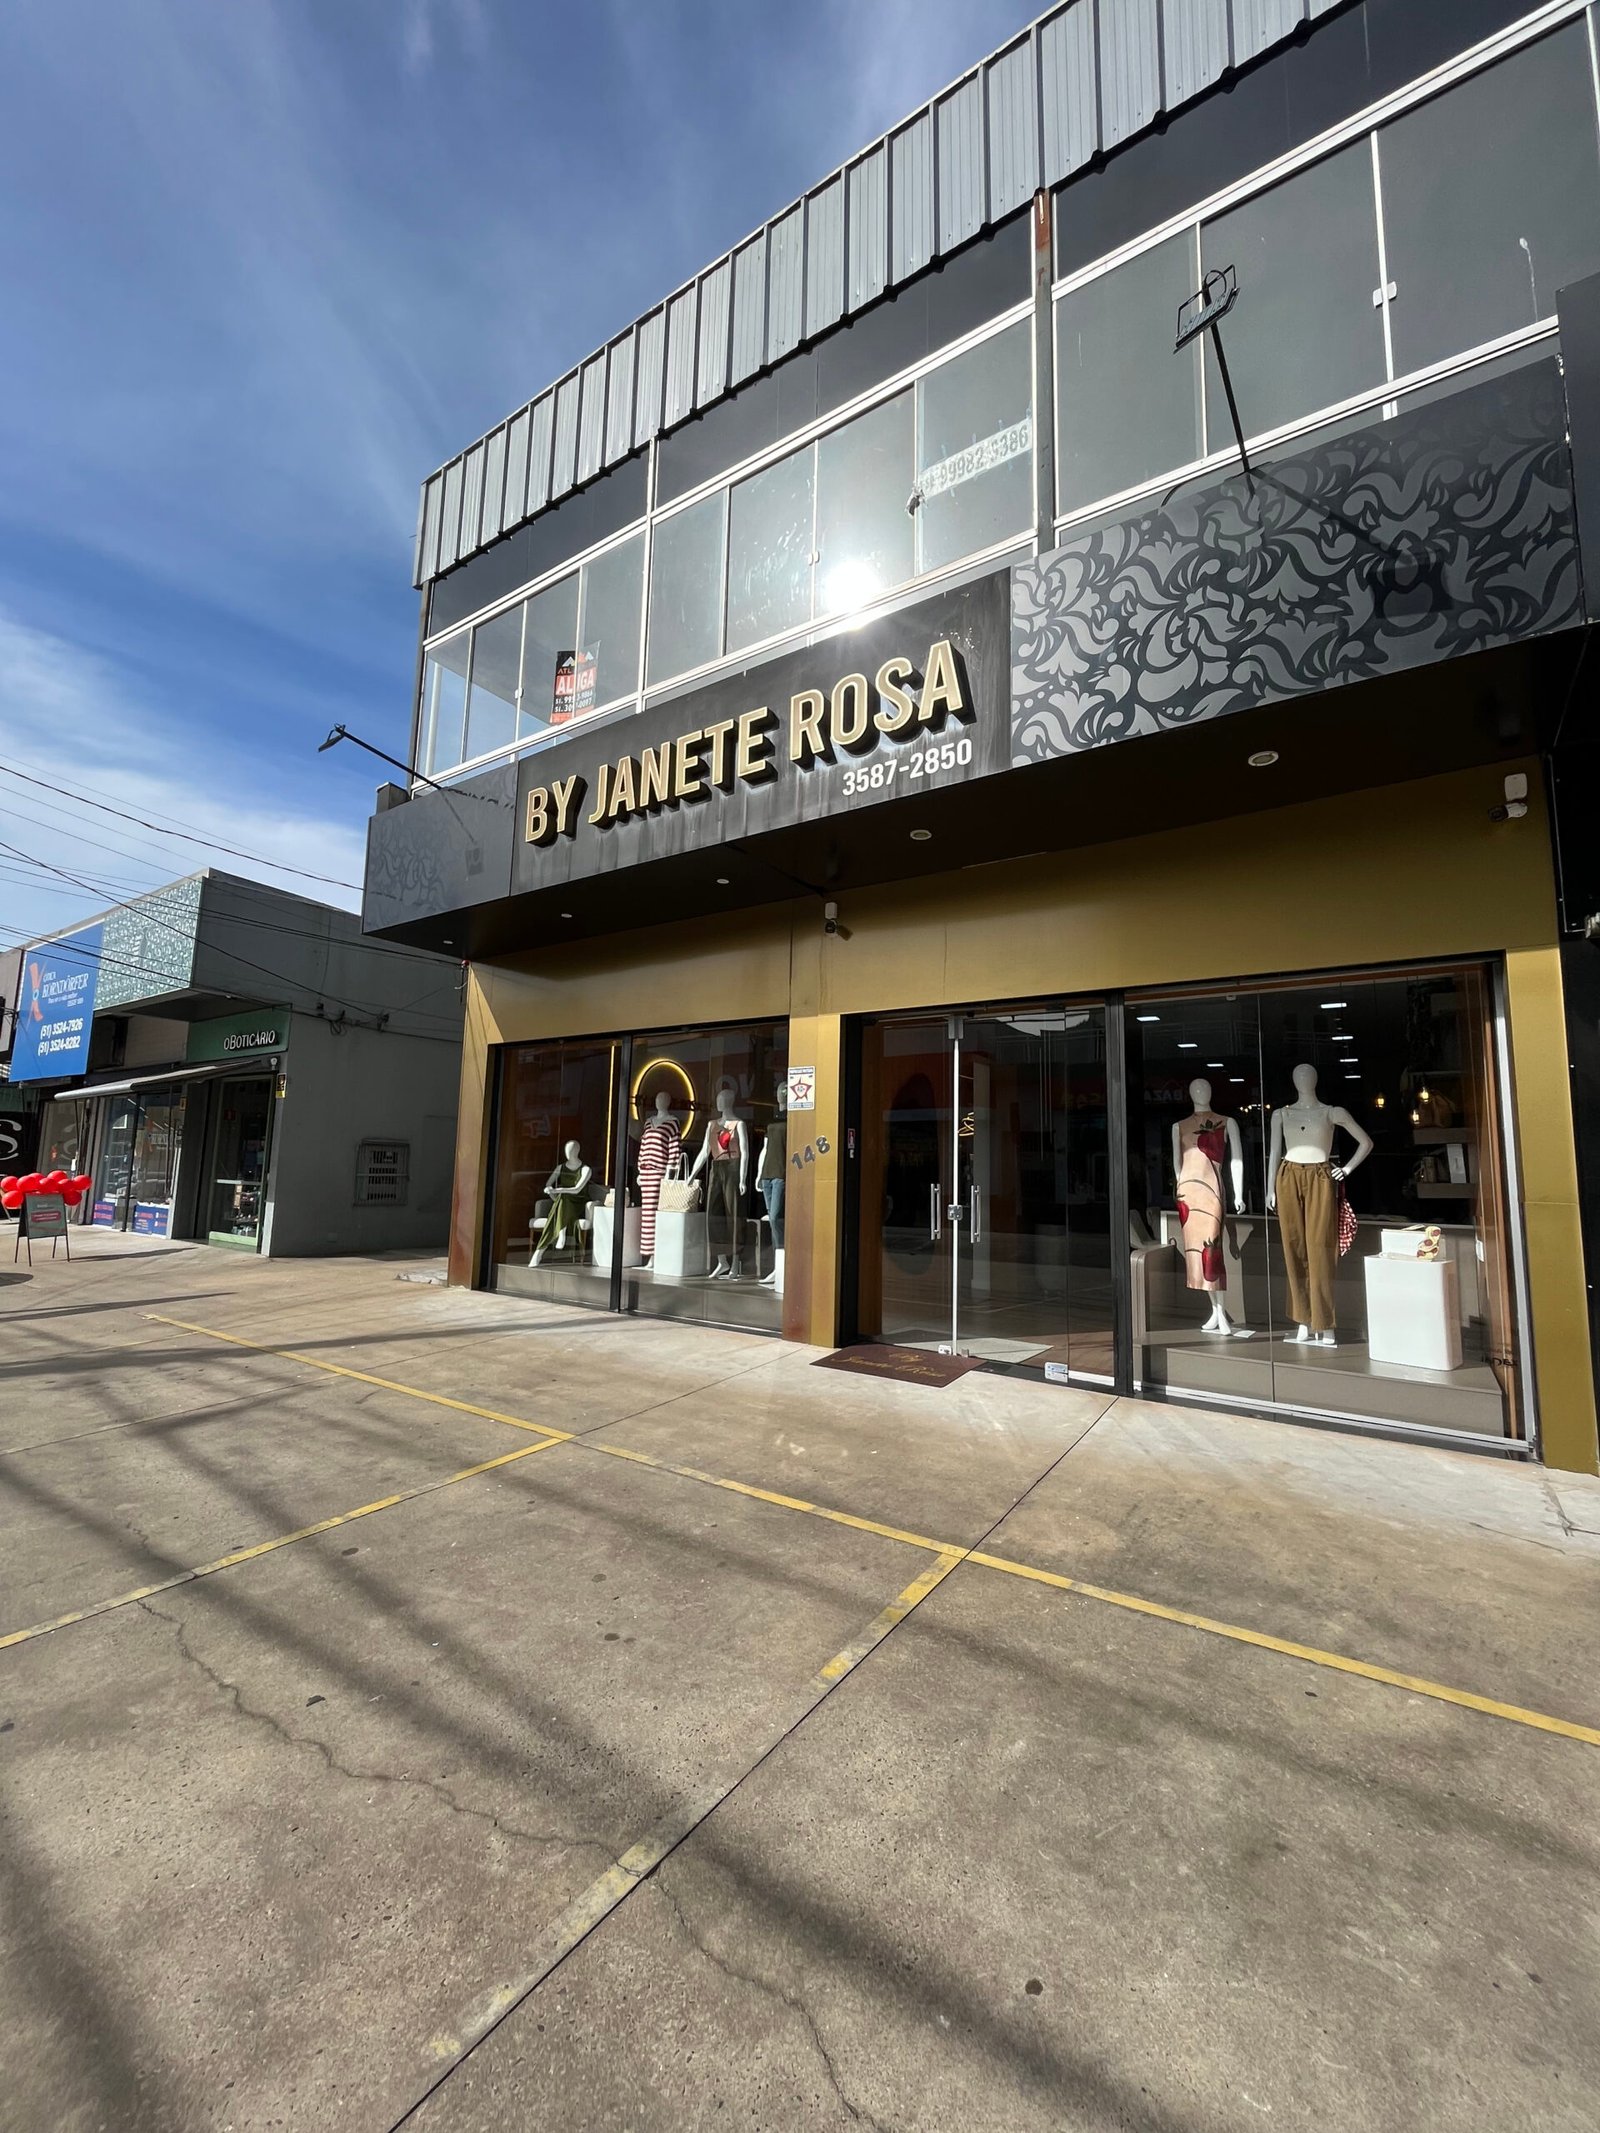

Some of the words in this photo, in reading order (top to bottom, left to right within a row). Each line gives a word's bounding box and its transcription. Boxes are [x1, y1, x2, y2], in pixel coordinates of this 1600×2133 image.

[525, 774, 578, 844] BY
[588, 706, 769, 824] JANETE
[790, 639, 965, 761] ROSA
[842, 738, 972, 796] 3587-2850
[38, 1041, 49, 1056] (51)
[40, 1024, 52, 1040] (51)
[792, 1135, 830, 1169] 148
